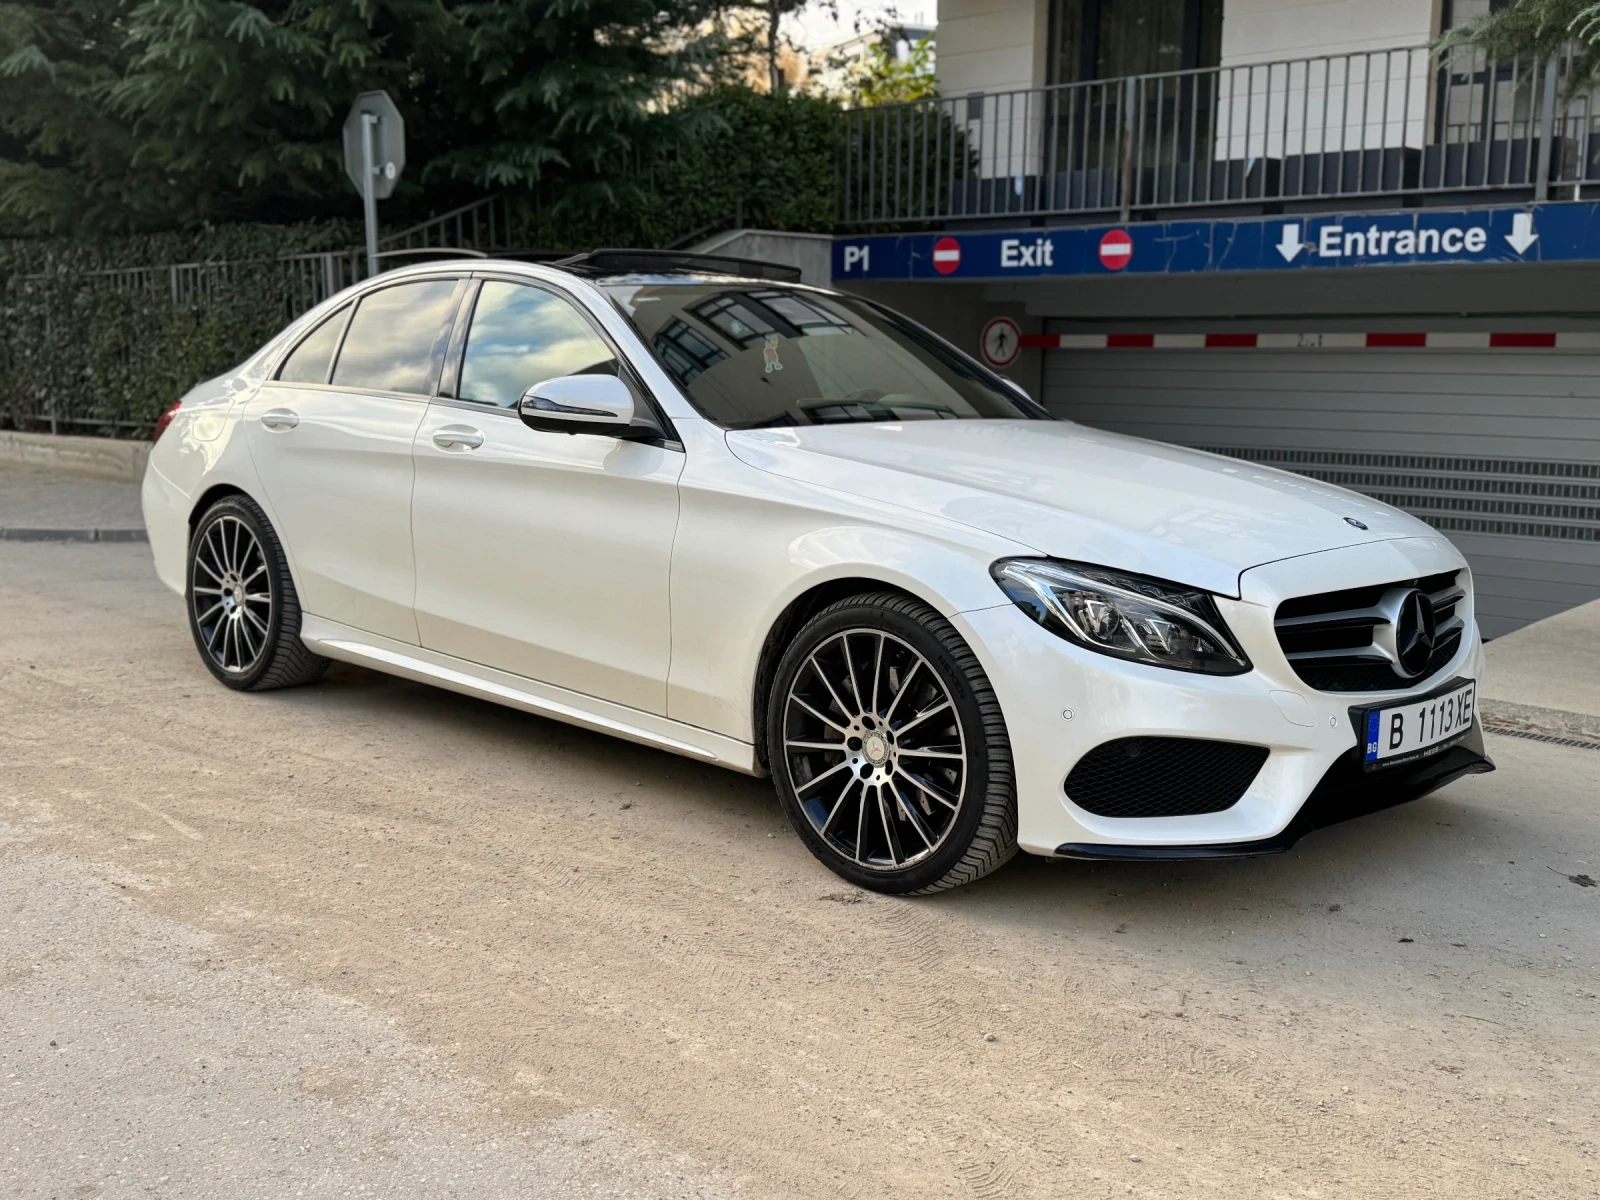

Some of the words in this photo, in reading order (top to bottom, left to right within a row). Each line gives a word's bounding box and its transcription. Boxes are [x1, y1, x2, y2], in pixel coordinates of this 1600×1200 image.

[1000, 238, 1054, 268] Exit
[1318, 224, 1487, 257] Entrance
[844, 245, 870, 272] P1
[1389, 713, 1404, 750] B
[1366, 741, 1378, 754] BG
